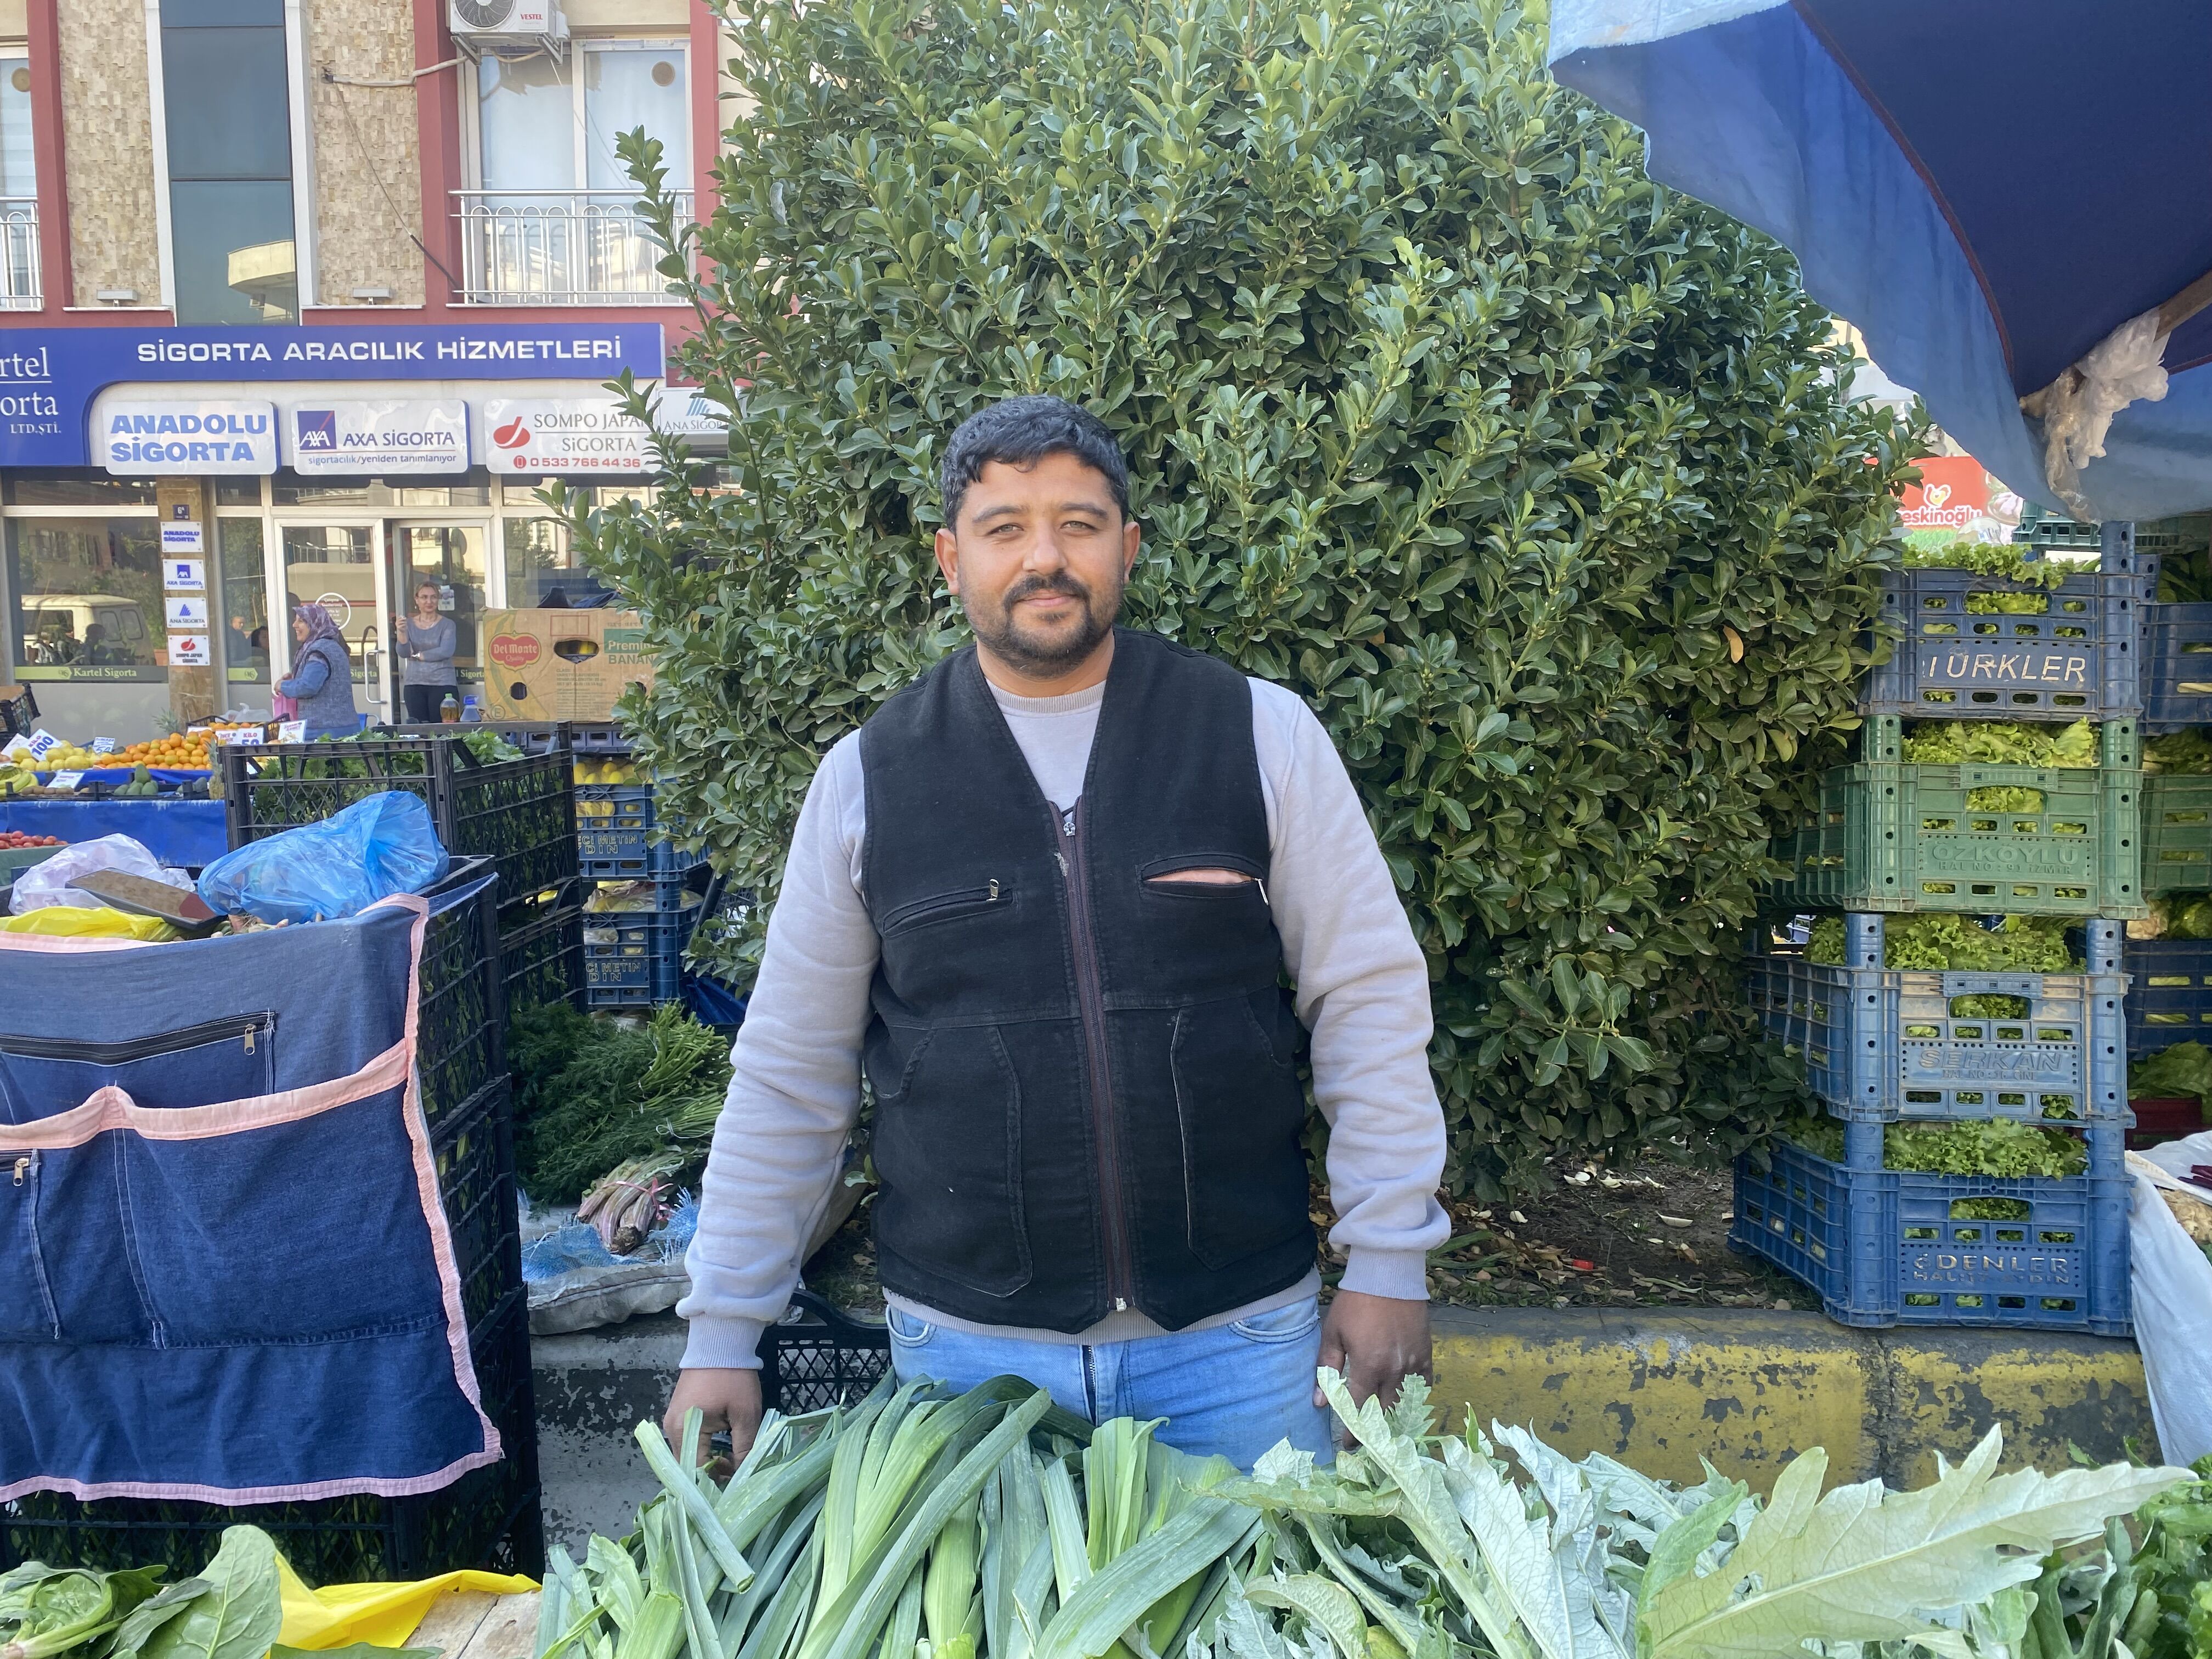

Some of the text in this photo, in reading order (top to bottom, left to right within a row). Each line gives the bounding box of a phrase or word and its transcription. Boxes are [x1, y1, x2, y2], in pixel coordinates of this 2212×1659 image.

[138, 335, 622, 362] SİGORTA ARACILIK HİZMETLERİ
[110, 414, 267, 435] ANADOLU
[534, 414, 597, 428] SOMPO
[664, 421, 689, 430] ANA
[300, 431, 331, 447] AXA
[343, 430, 455, 447] AXA SİGORTA
[111, 437, 255, 462] SİGORTA
[400, 454, 456, 464] tanımlanıyor
[531, 458, 641, 467] 0 533 766 44 36
[494, 644, 537, 654] Del Monte
[73, 668, 103, 676] Kartel
[104, 667, 137, 678] Sigorta
[350, 669, 377, 679] Sigota
[31, 736, 54, 755] 100
[597, 835, 638, 845] METİN
[1932, 840, 2079, 865] ÖZKÖYLÜ
[1939, 861, 1966, 871] HAL
[601, 962, 641, 972] METİN
[1918, 1049, 2063, 1072] SERKAN
[1913, 1252, 2069, 1274] ÖDENLER
